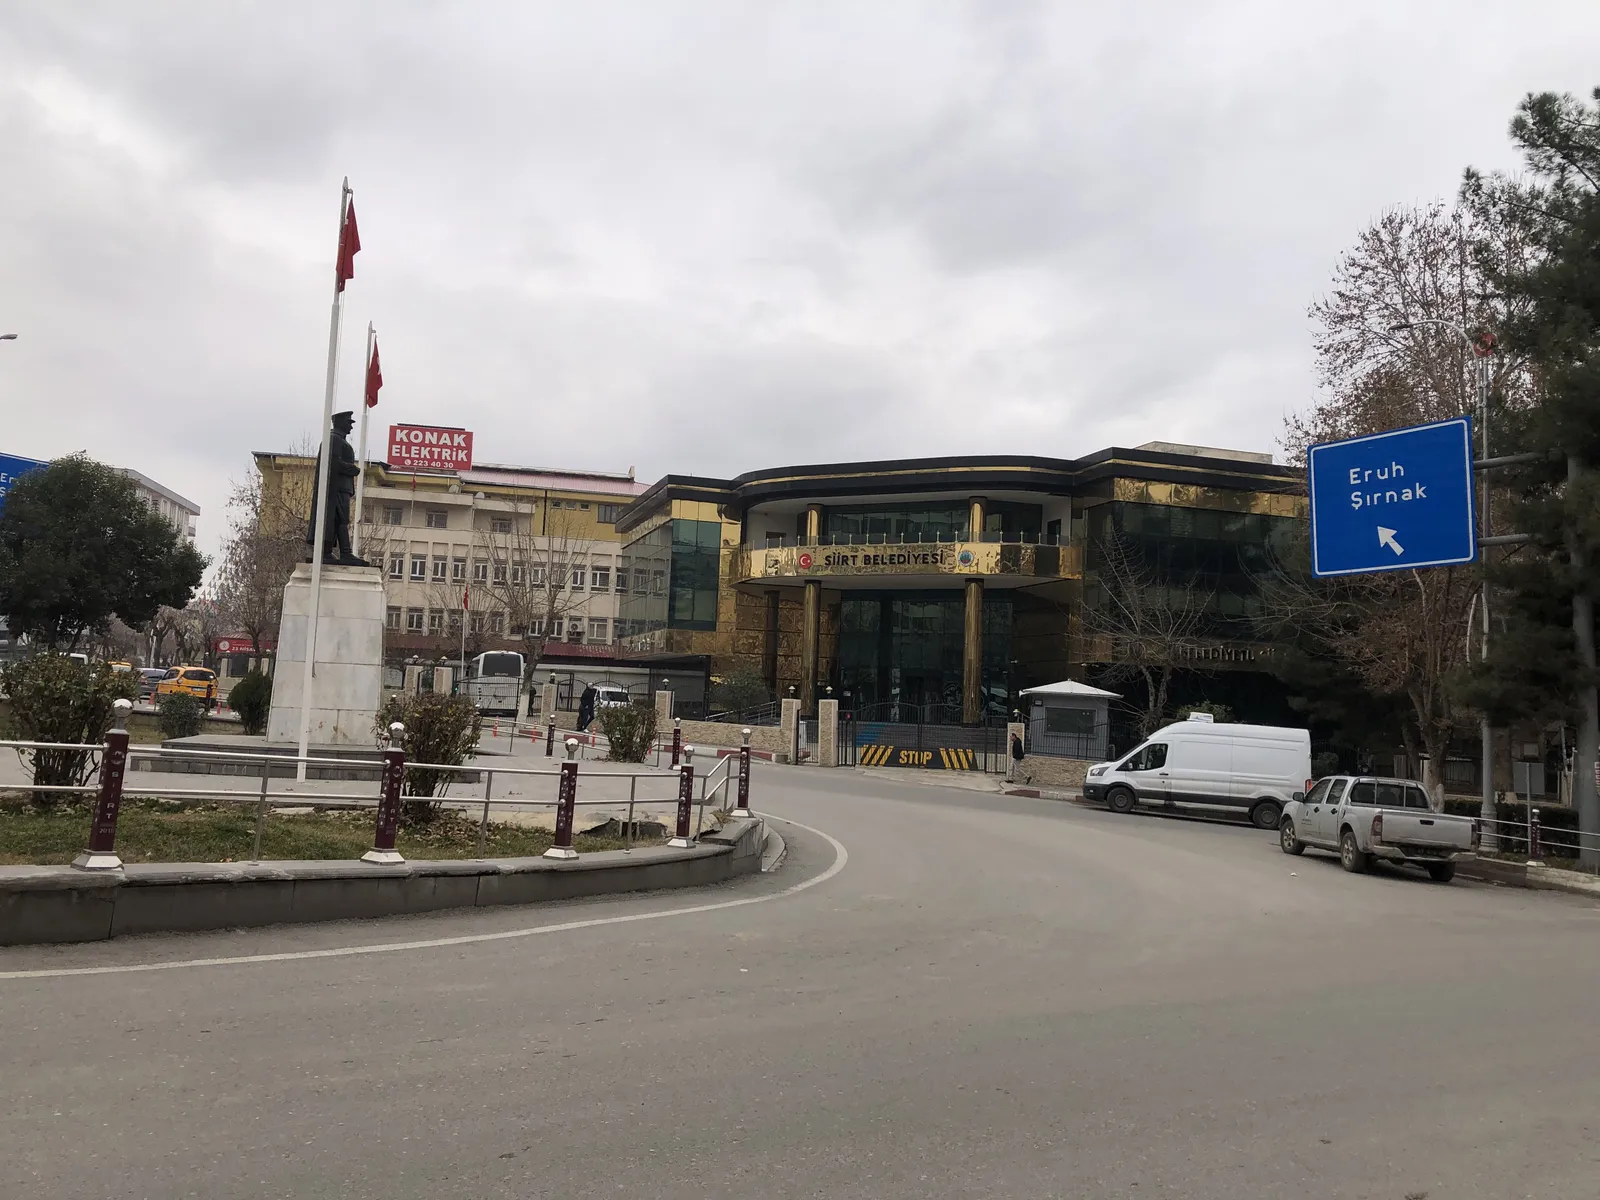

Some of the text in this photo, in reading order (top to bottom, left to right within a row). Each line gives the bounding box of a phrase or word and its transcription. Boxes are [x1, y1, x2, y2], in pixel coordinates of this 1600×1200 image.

[395, 429, 467, 447] KONAK
[391, 444, 468, 462] ELEKTRİK
[413, 459, 428, 467] 223
[430, 460, 441, 468] 40
[1349, 461, 1404, 485] Eruh
[1351, 482, 1427, 510] Şırnak
[824, 550, 944, 566] SİİRT BELEDİYESİ
[899, 750, 933, 765] STOP
